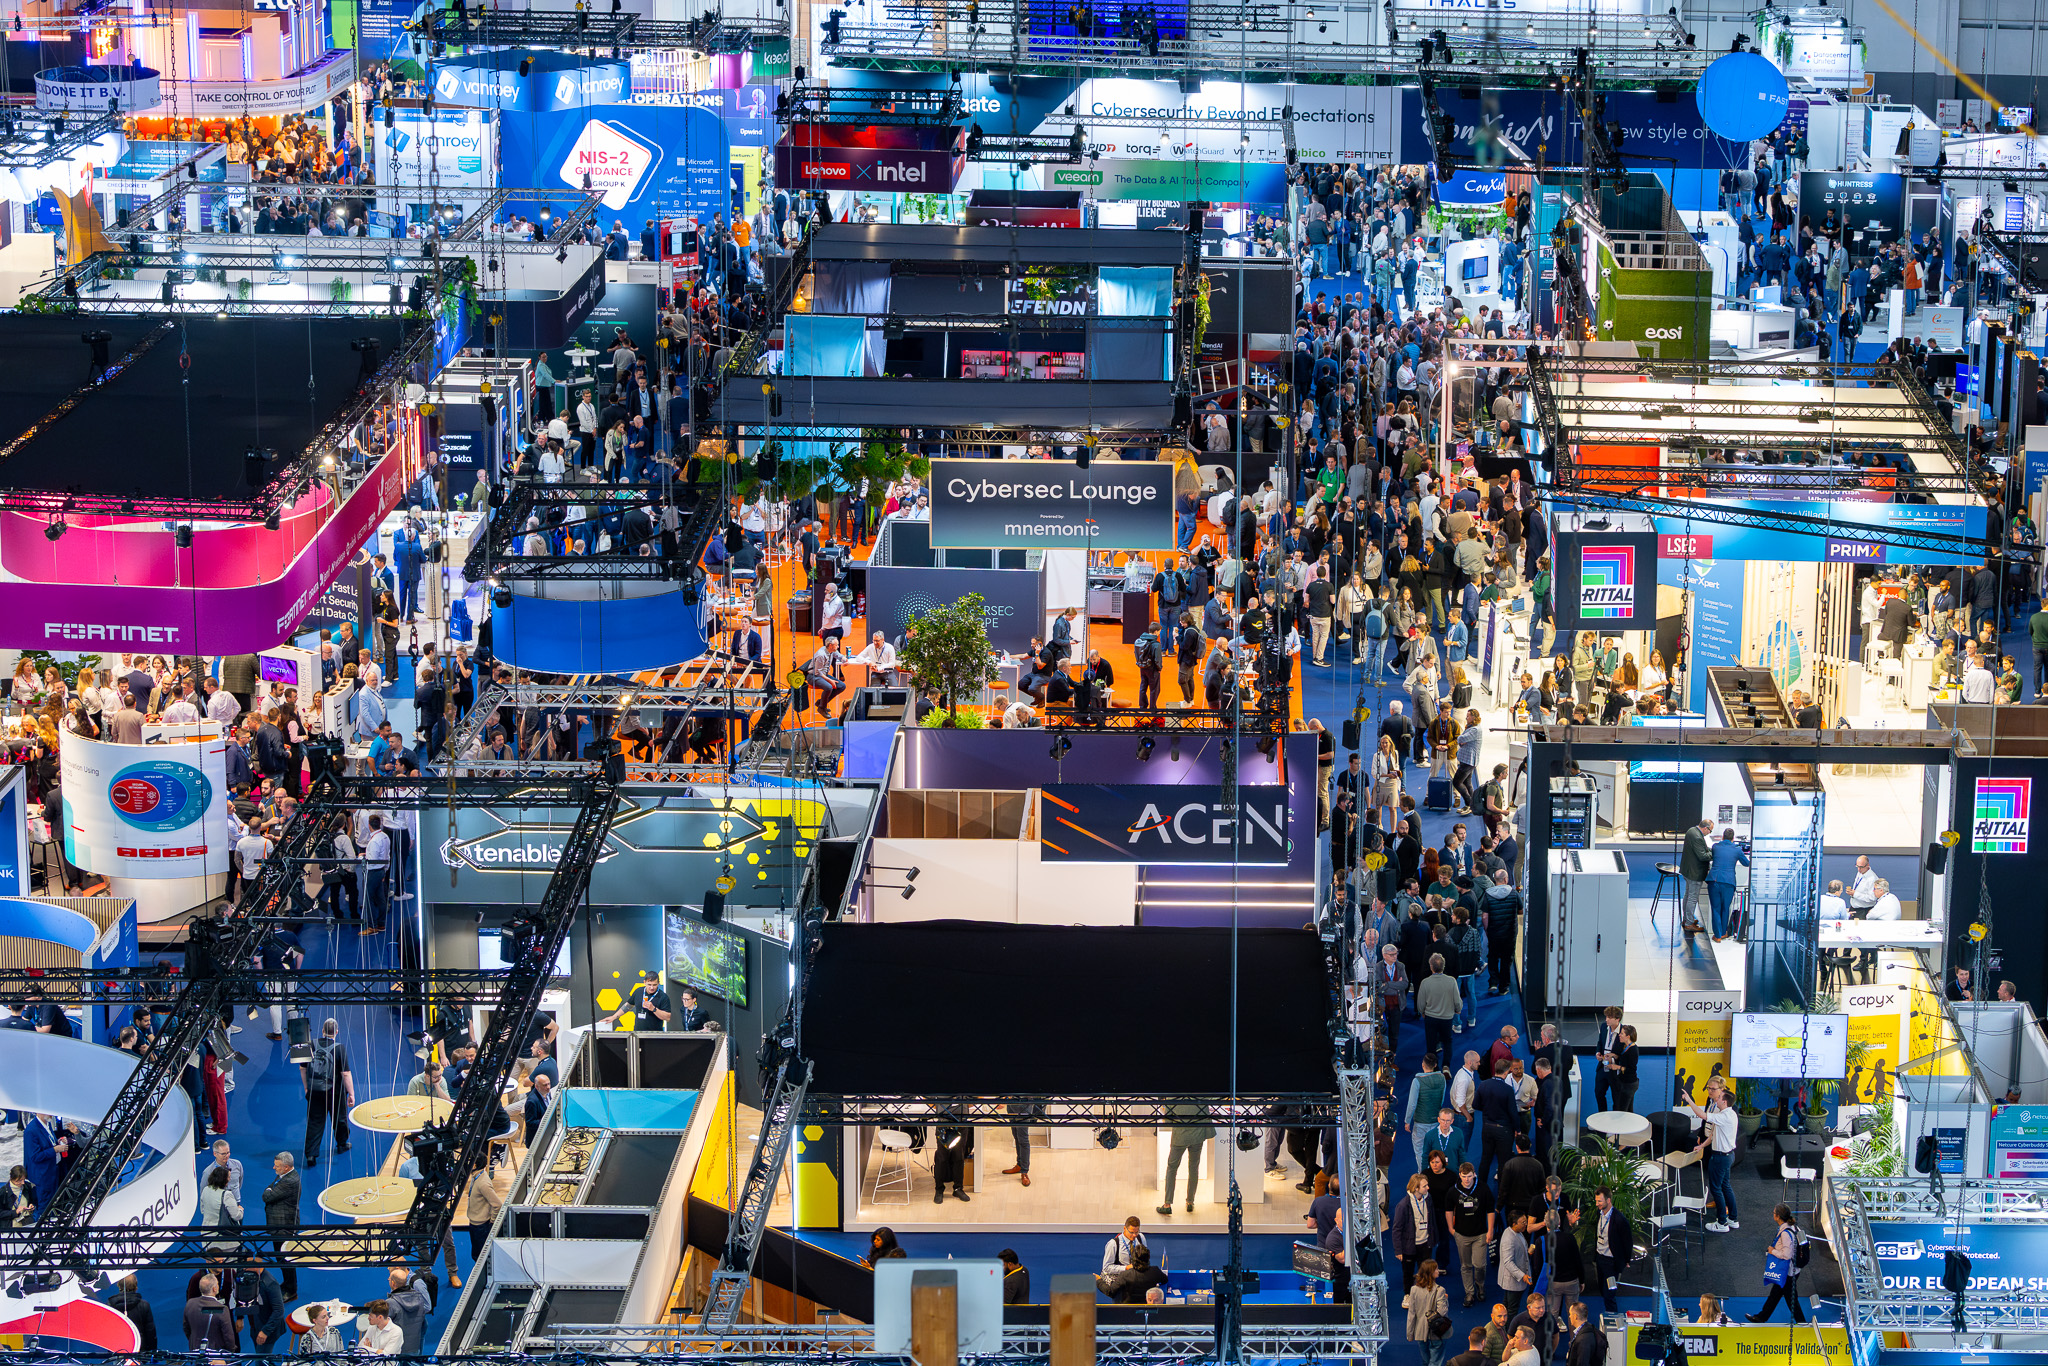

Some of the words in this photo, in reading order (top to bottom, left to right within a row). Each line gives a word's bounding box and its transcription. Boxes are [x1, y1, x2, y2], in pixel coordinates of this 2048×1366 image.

[463, 80, 520, 103] vanroey
[578, 76, 624, 94] vanroey
[80, 88, 95, 98] IT
[194, 94, 222, 103] TAKE
[224, 92, 272, 102] CONTROL
[273, 91, 284, 100] OF
[286, 88, 305, 98] YOUR
[635, 94, 724, 106] OPERATIONS
[1092, 102, 1203, 119] Cybersecurity
[1208, 106, 1267, 120] Beyond
[1272, 107, 1374, 124] Epectations
[1648, 122, 1687, 144] style
[416, 136, 480, 152] vanroey
[579, 151, 629, 164] NIS-2
[1126, 144, 1152, 156] torq
[1297, 148, 1326, 158] ubico
[1336, 151, 1394, 160] FORTINET
[575, 167, 633, 176] GUIDANCE
[805, 165, 846, 176] Lenovo
[877, 160, 926, 182] intel
[1058, 172, 1100, 182] veeam
[1115, 174, 1131, 184] The
[1134, 176, 1156, 184] Data
[1160, 176, 1166, 184] &
[1169, 176, 1179, 184] AI
[1182, 177, 1202, 185] Trust
[1206, 177, 1250, 188] Company
[1645, 326, 1682, 340] easi
[452, 455, 472, 463] okta
[948, 478, 1063, 503] Cybersec
[1070, 480, 1157, 505] Lounge
[1004, 522, 1100, 537] mnemonic
[1666, 538, 1696, 552] LSEC
[1830, 544, 1880, 557] PRIMX
[332, 582, 350, 594] Fast
[1676, 574, 1720, 590] CyberXpert
[1582, 588, 1633, 602] RITTAL
[276, 588, 307, 635] FORTINET
[329, 595, 358, 614] Security
[326, 609, 346, 620] Data
[44, 622, 179, 642] FORTINET
[1128, 802, 1283, 848] ACEN
[1975, 822, 2026, 836] RITTAL
[474, 842, 562, 864] tenable
[1686, 1000, 1733, 1013] capyx
[1849, 994, 1894, 1008] capyx
[1684, 1028, 1708, 1037] Always
[1849, 1024, 1871, 1032] Always
[1684, 1036, 1706, 1044] bright,
[1697, 1046, 1724, 1054] beyond.
[1926, 1277, 2024, 1290] EUOPEAN
[1736, 1342, 1751, 1354] The
[1754, 1343, 1792, 1356] Exposure
[1795, 1342, 1838, 1355] Validaion
